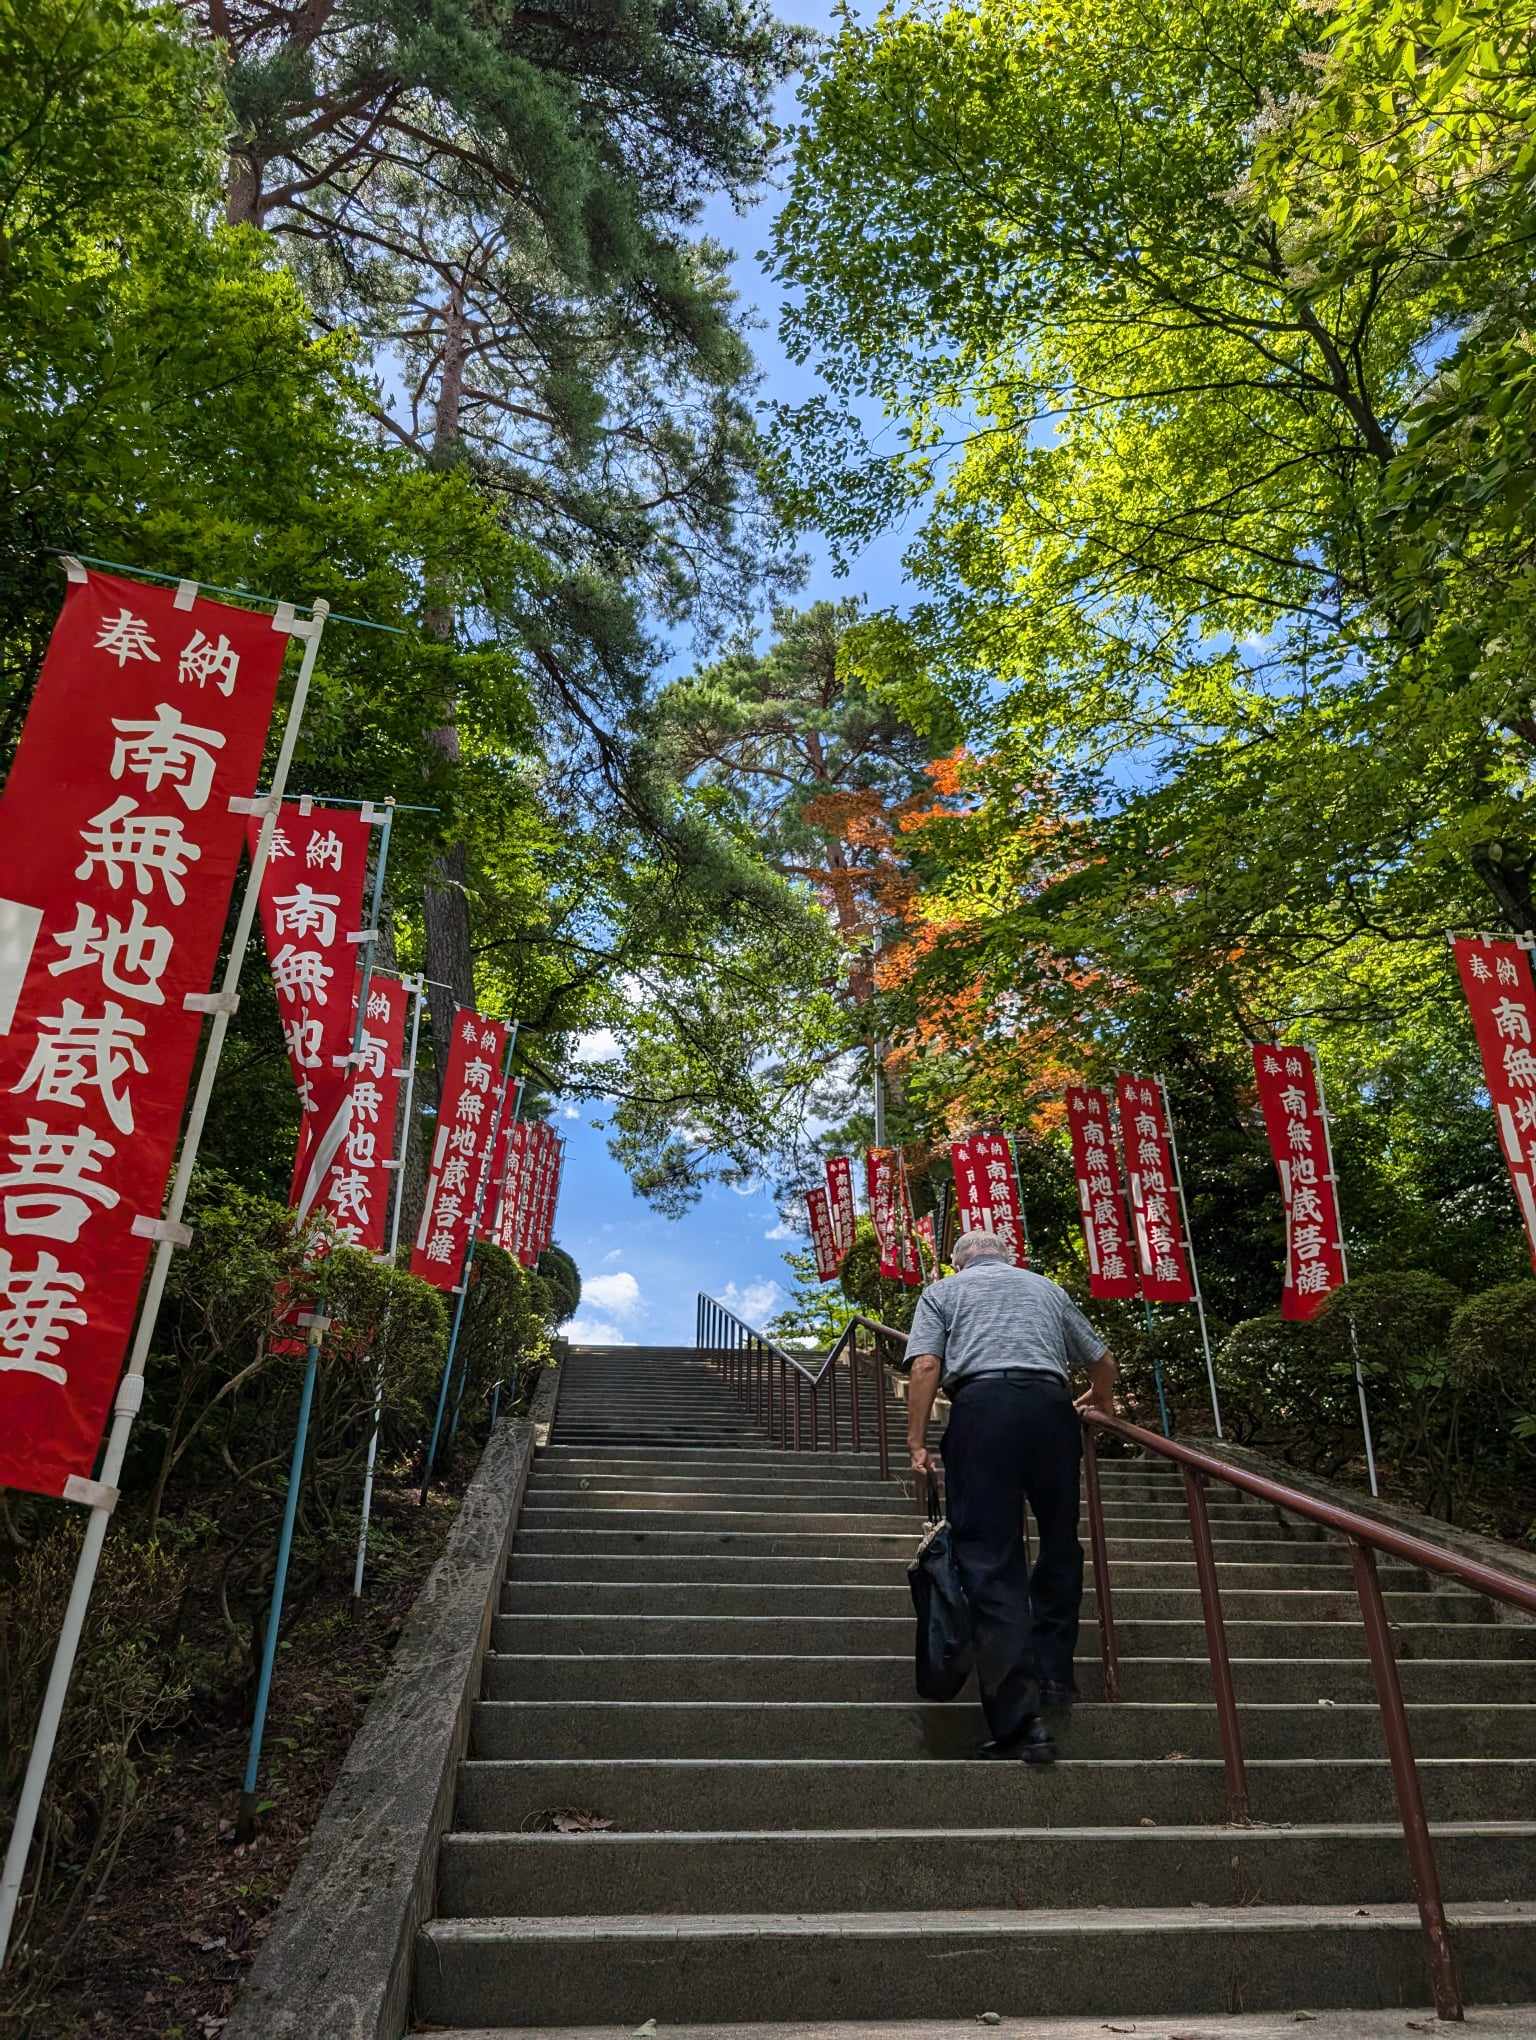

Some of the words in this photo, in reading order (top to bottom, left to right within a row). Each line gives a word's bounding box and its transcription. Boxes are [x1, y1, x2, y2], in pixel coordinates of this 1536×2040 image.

[94, 608, 241, 698] 奉納
[257, 827, 343, 872] 奉納
[1469, 953, 1519, 988] 奉納
[0, 702, 227, 1386] 南無地蔵菩薩
[461, 1021, 498, 1055] 奉納
[1263, 1055, 1303, 1078] 奉納
[1072, 1095, 1100, 1115] 奉納
[1125, 1084, 1153, 1106] 奉納
[426, 1056, 493, 1265] 南無地蔵菩薩
[976, 1142, 1003, 1156] 奉納
[1082, 1120, 1128, 1280] 南無地蔵菩薩
[1134, 1111, 1181, 1282] 南無地蔵菩薩
[1279, 1084, 1332, 1297] 南無地蔵菩薩
